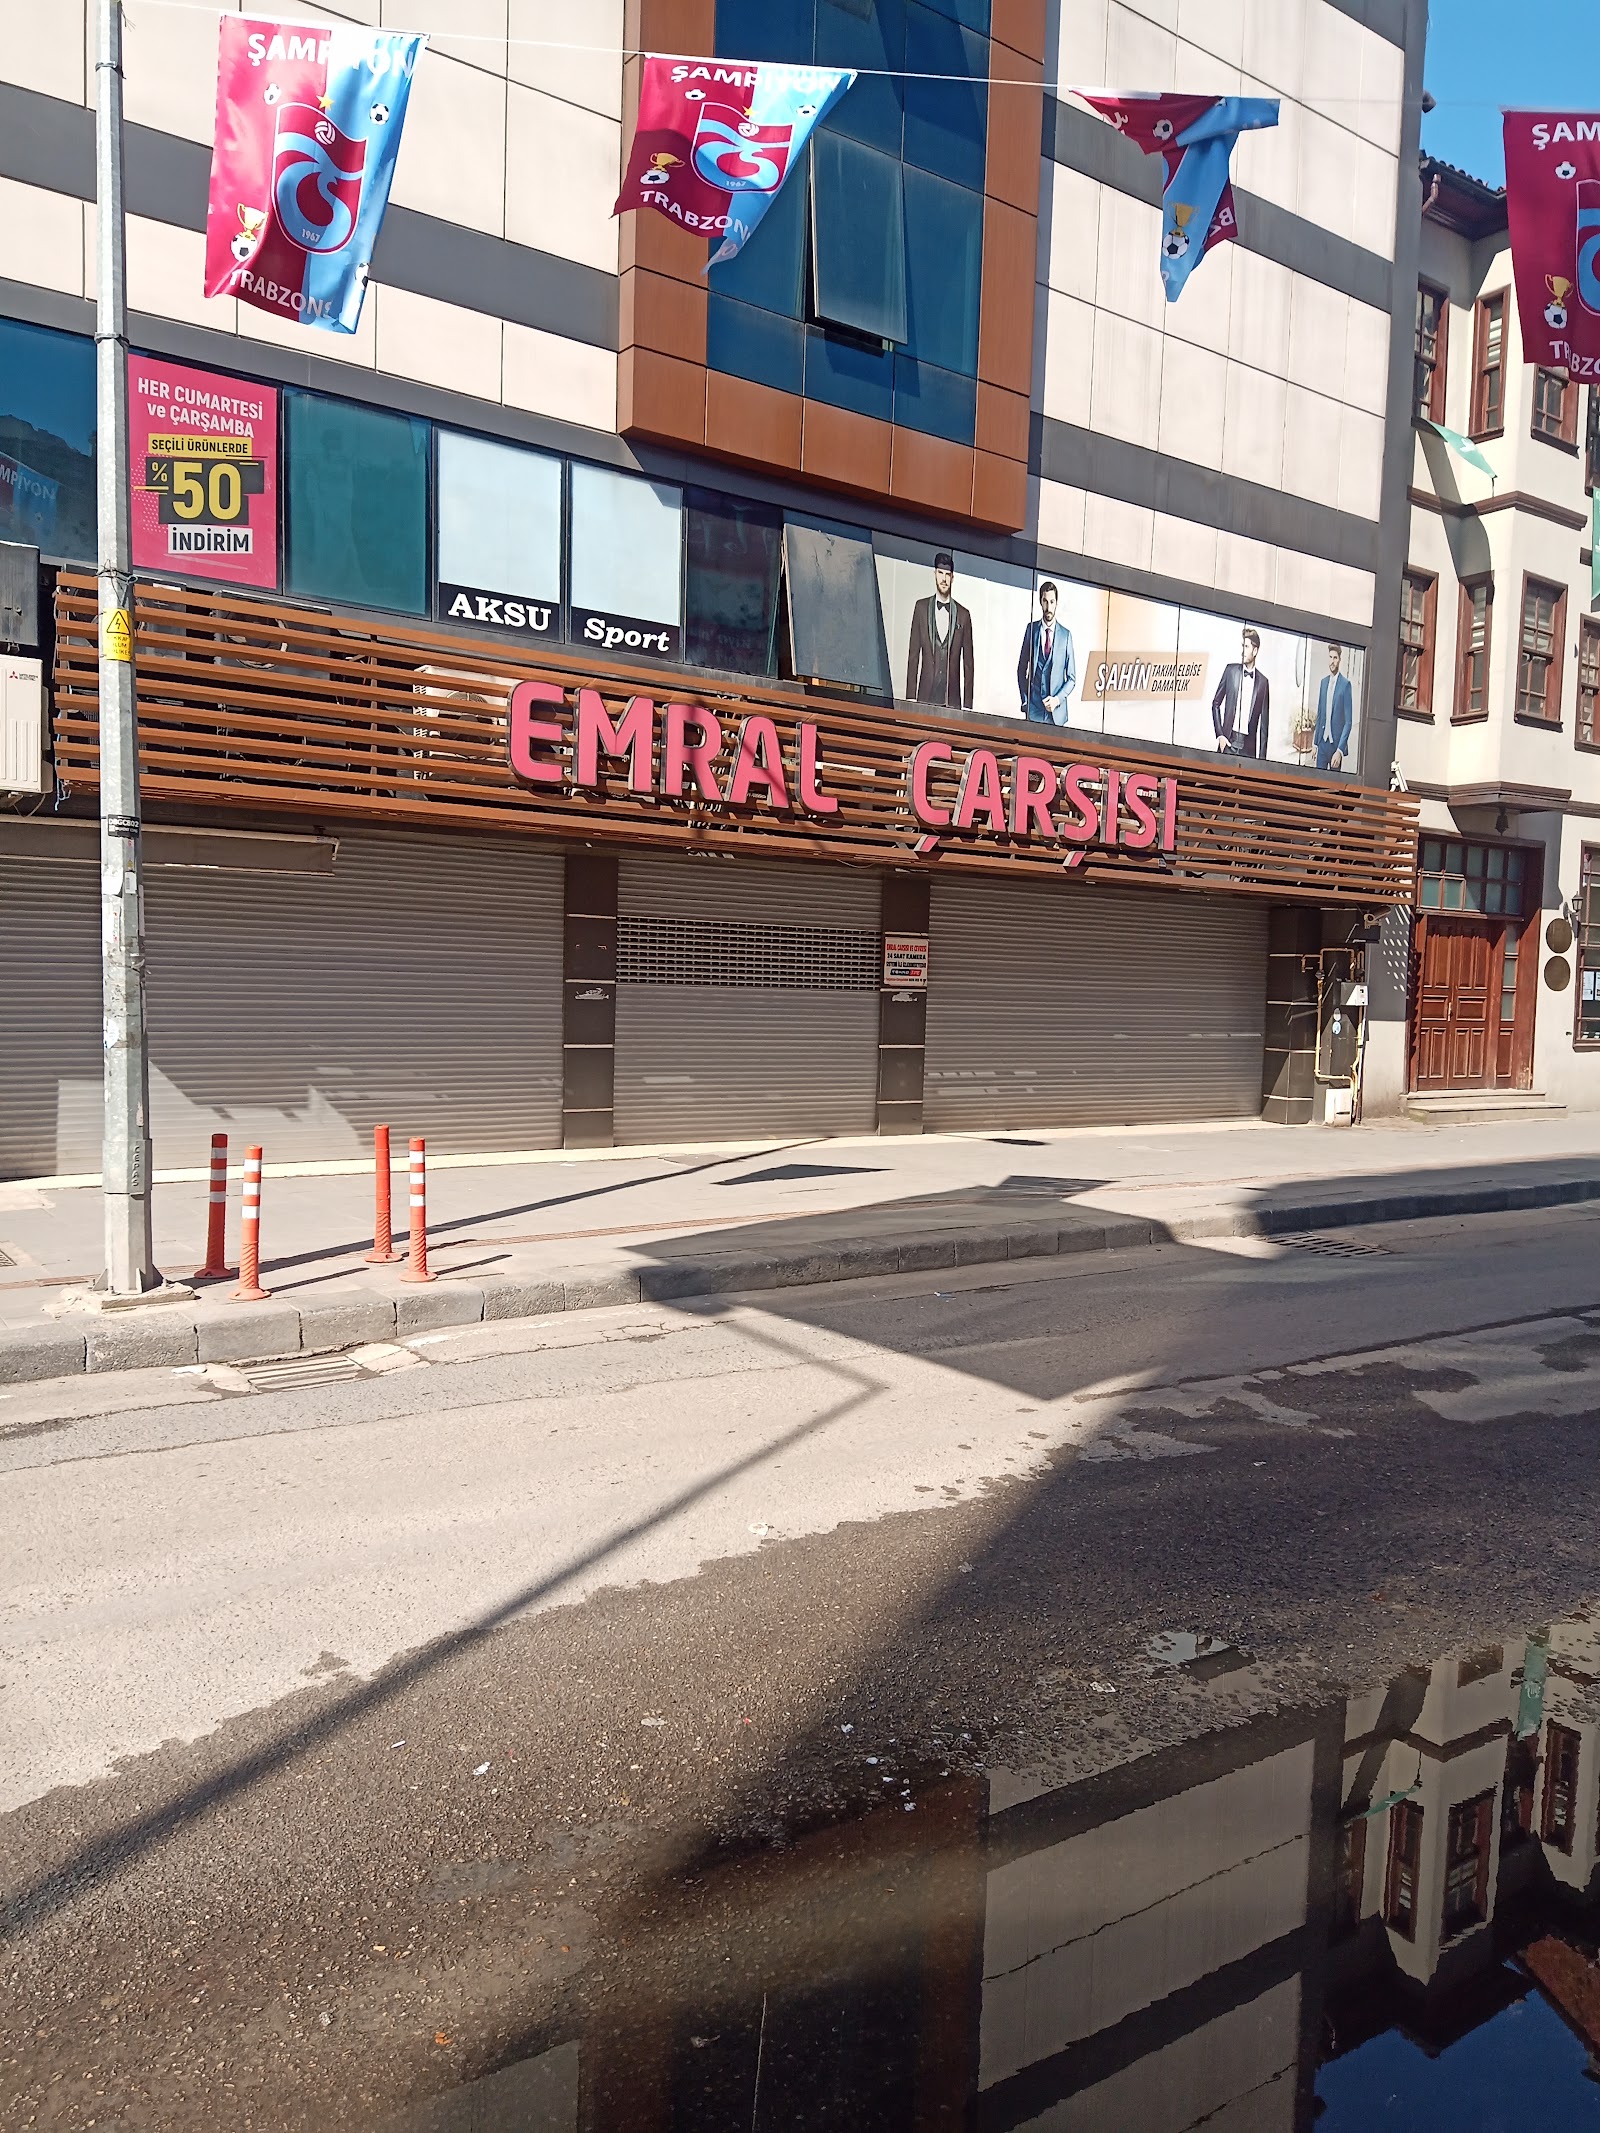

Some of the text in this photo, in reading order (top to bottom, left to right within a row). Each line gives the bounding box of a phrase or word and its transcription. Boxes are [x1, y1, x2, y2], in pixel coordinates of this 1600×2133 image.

[301, 228, 321, 243] 1967
[138, 377, 264, 421] HER CUMARTESİ
[147, 402, 254, 438] ve ÇARŞAMBA
[152, 437, 249, 454] SEÇİLİ ÜRÜNLERDE
[172, 526, 249, 552] İNDİRİM
[448, 592, 552, 631] AKSU
[583, 617, 671, 652] Sport
[1094, 657, 1203, 697] ŞAHİN TAKIM ELBİSE
[1151, 679, 1191, 692] DAMATLIK
[507, 680, 1177, 867] EMRAL ÇARŞISI
